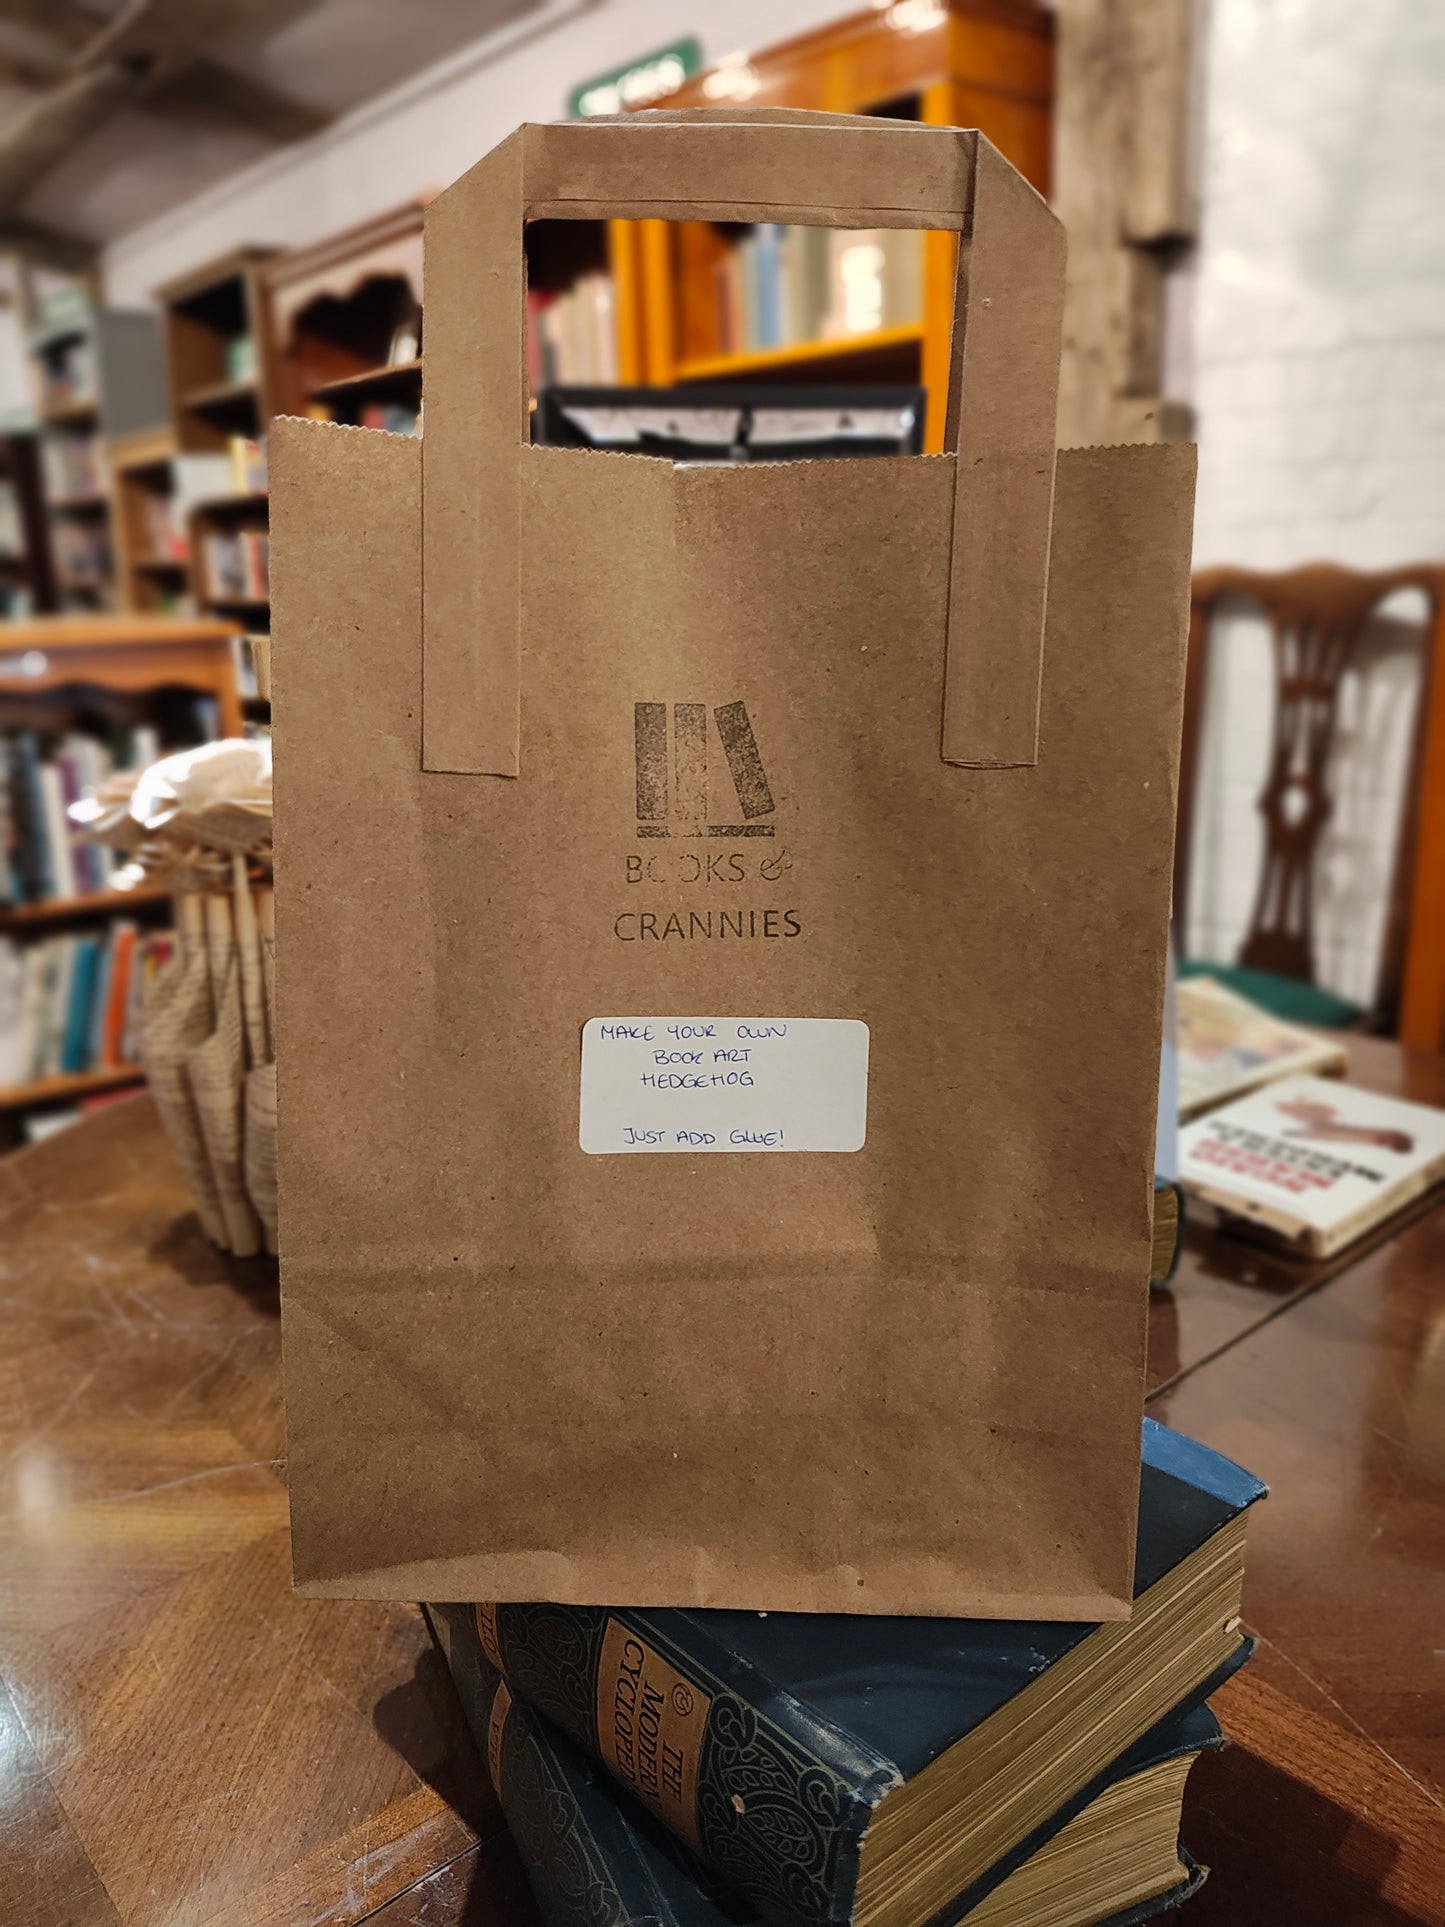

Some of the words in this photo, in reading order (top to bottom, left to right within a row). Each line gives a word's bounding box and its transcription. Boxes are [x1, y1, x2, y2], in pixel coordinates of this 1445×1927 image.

[614, 909, 801, 941] CRANNIES
[600, 1024, 655, 1041] MAKE
[667, 1024, 718, 1040] YOUR
[737, 1023, 788, 1039] OWN
[652, 1048, 704, 1065] BOOK
[713, 1048, 752, 1063] ART
[640, 1071, 755, 1089] HEDGEHOG
[623, 1127, 665, 1145] JUST
[676, 1130, 716, 1145] ADD
[729, 1129, 785, 1148] GLUE!
[637, 1680, 665, 1809] MODERN
[662, 1740, 684, 1804] THE
